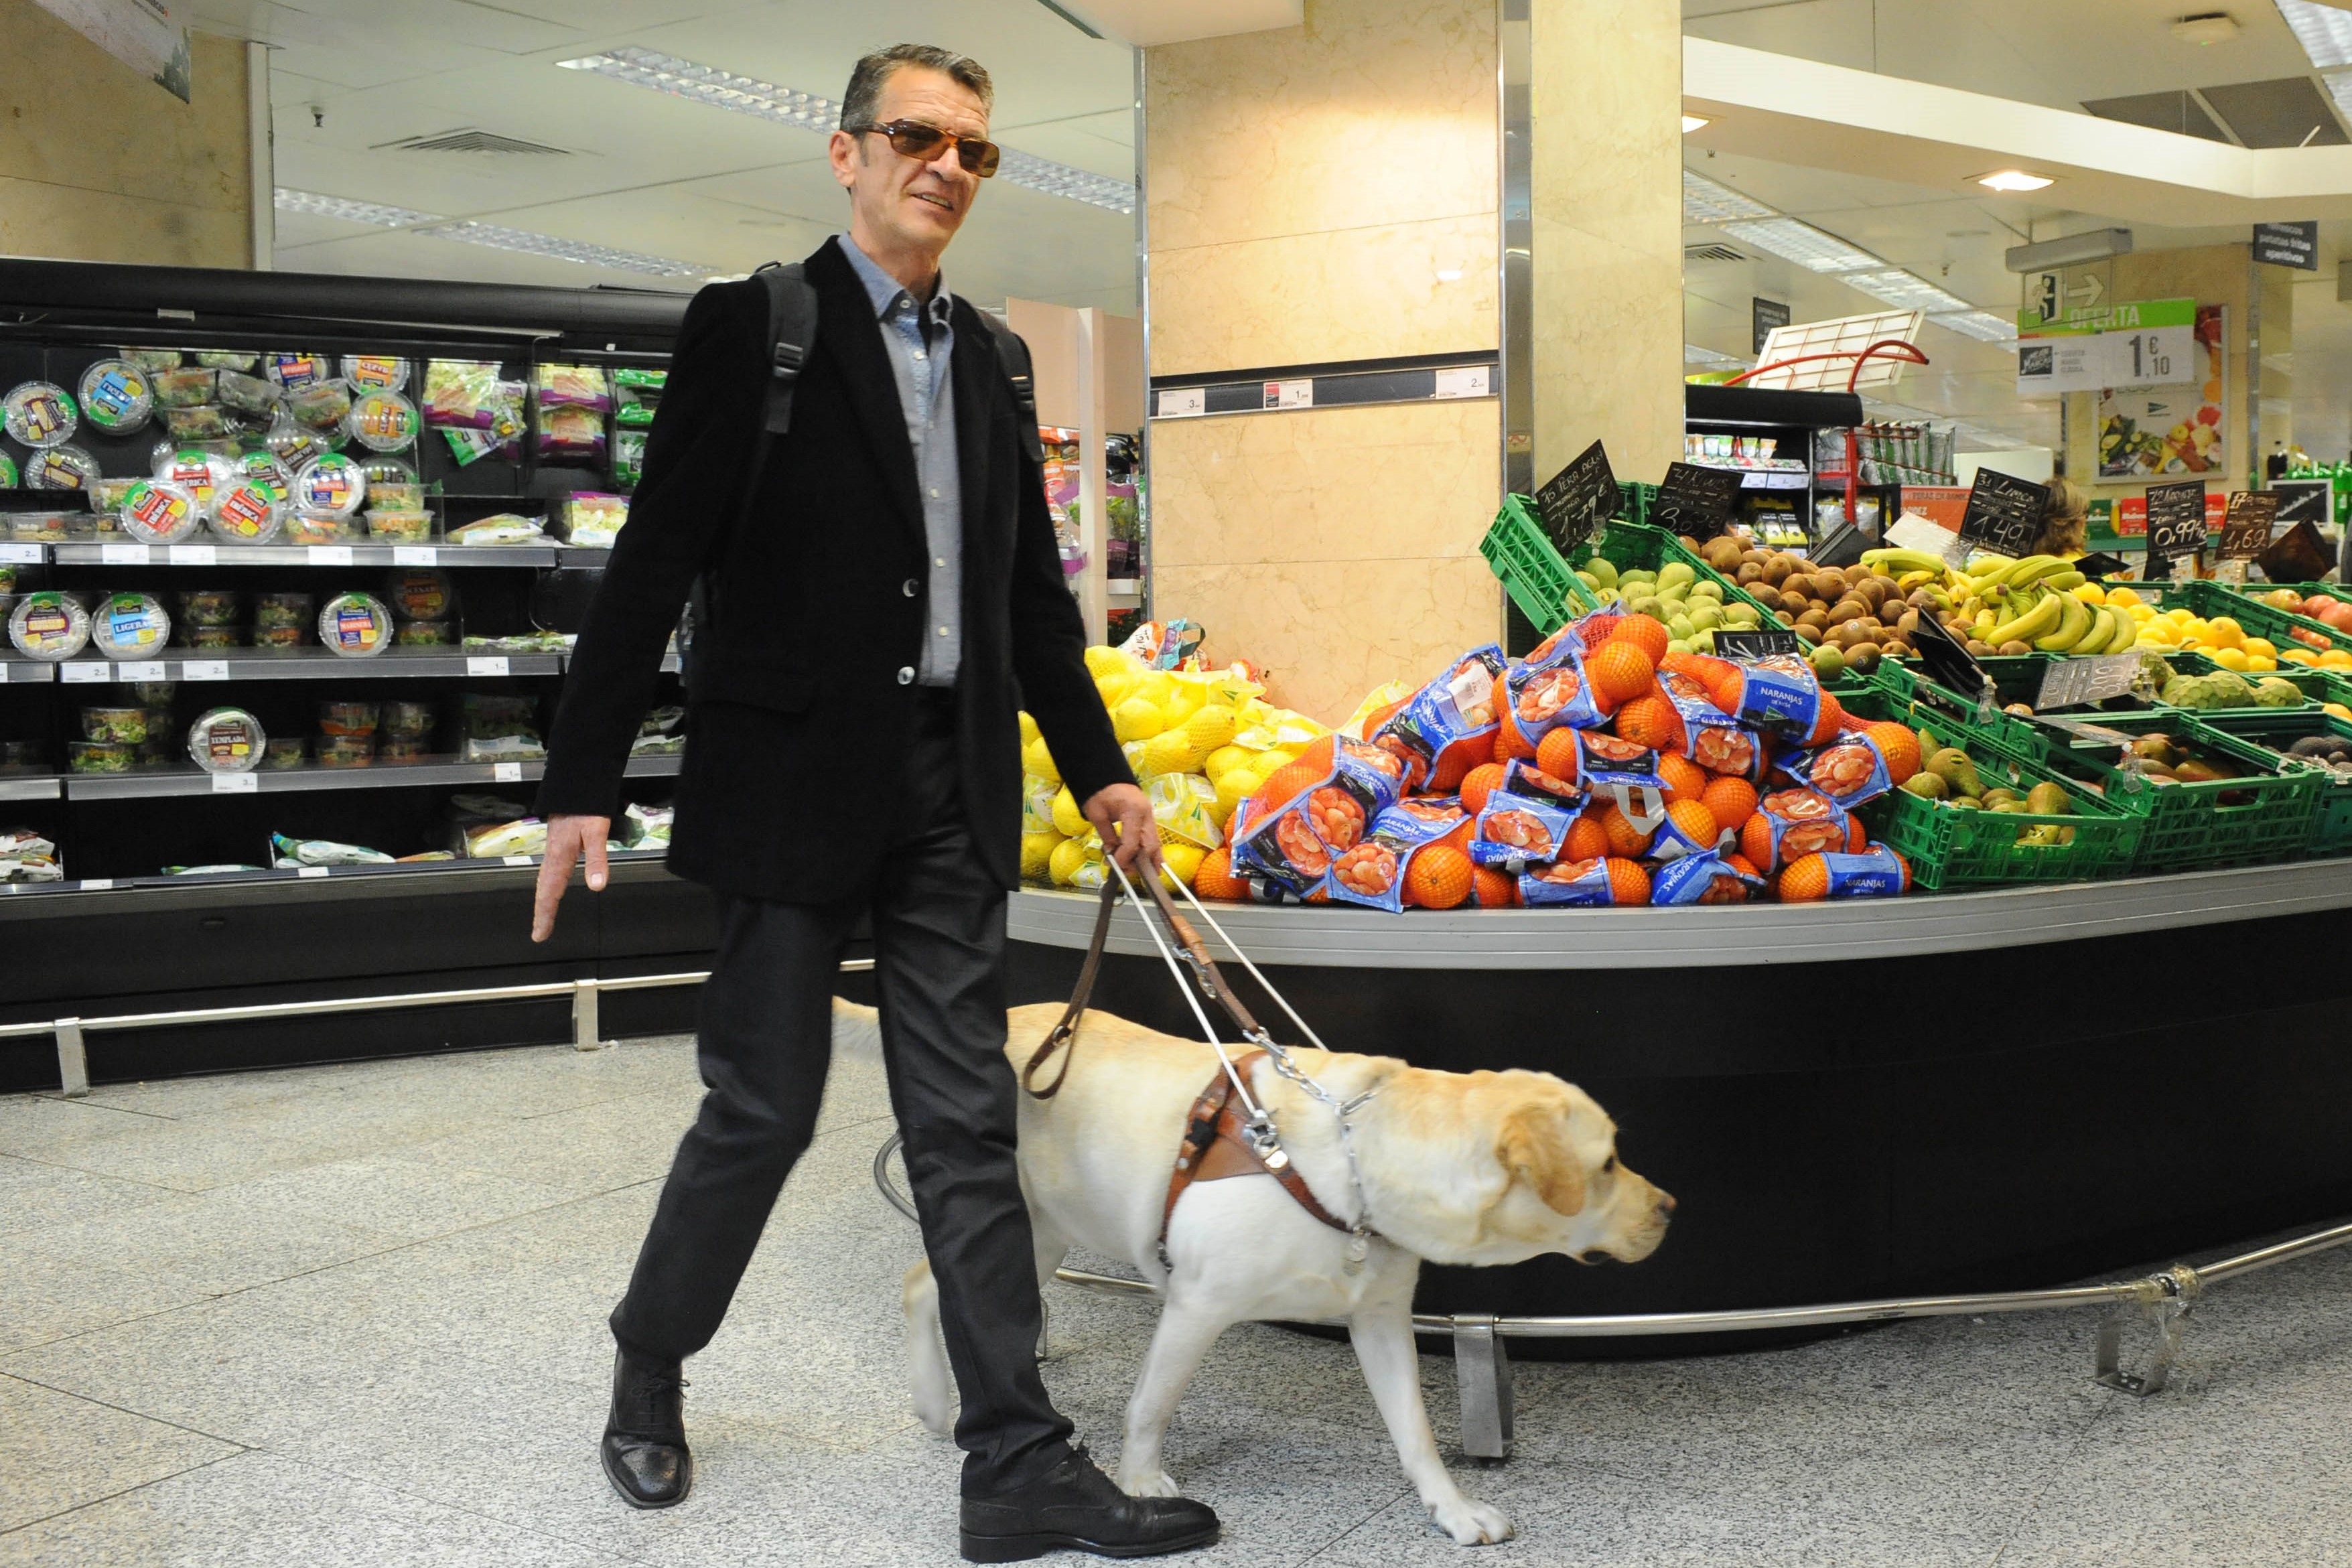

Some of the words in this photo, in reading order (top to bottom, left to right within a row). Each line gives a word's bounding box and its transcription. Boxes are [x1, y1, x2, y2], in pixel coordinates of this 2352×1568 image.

[2069, 305, 2140, 330] OFERTA
[2128, 335, 2142, 377] 1
[2154, 518, 2197, 547] 0,99
[2223, 528, 2266, 550] 1,69
[115, 619, 149, 634] LIGERA
[1760, 687, 1803, 705] NARANJAS
[1845, 879, 1886, 889] NARANJAS
